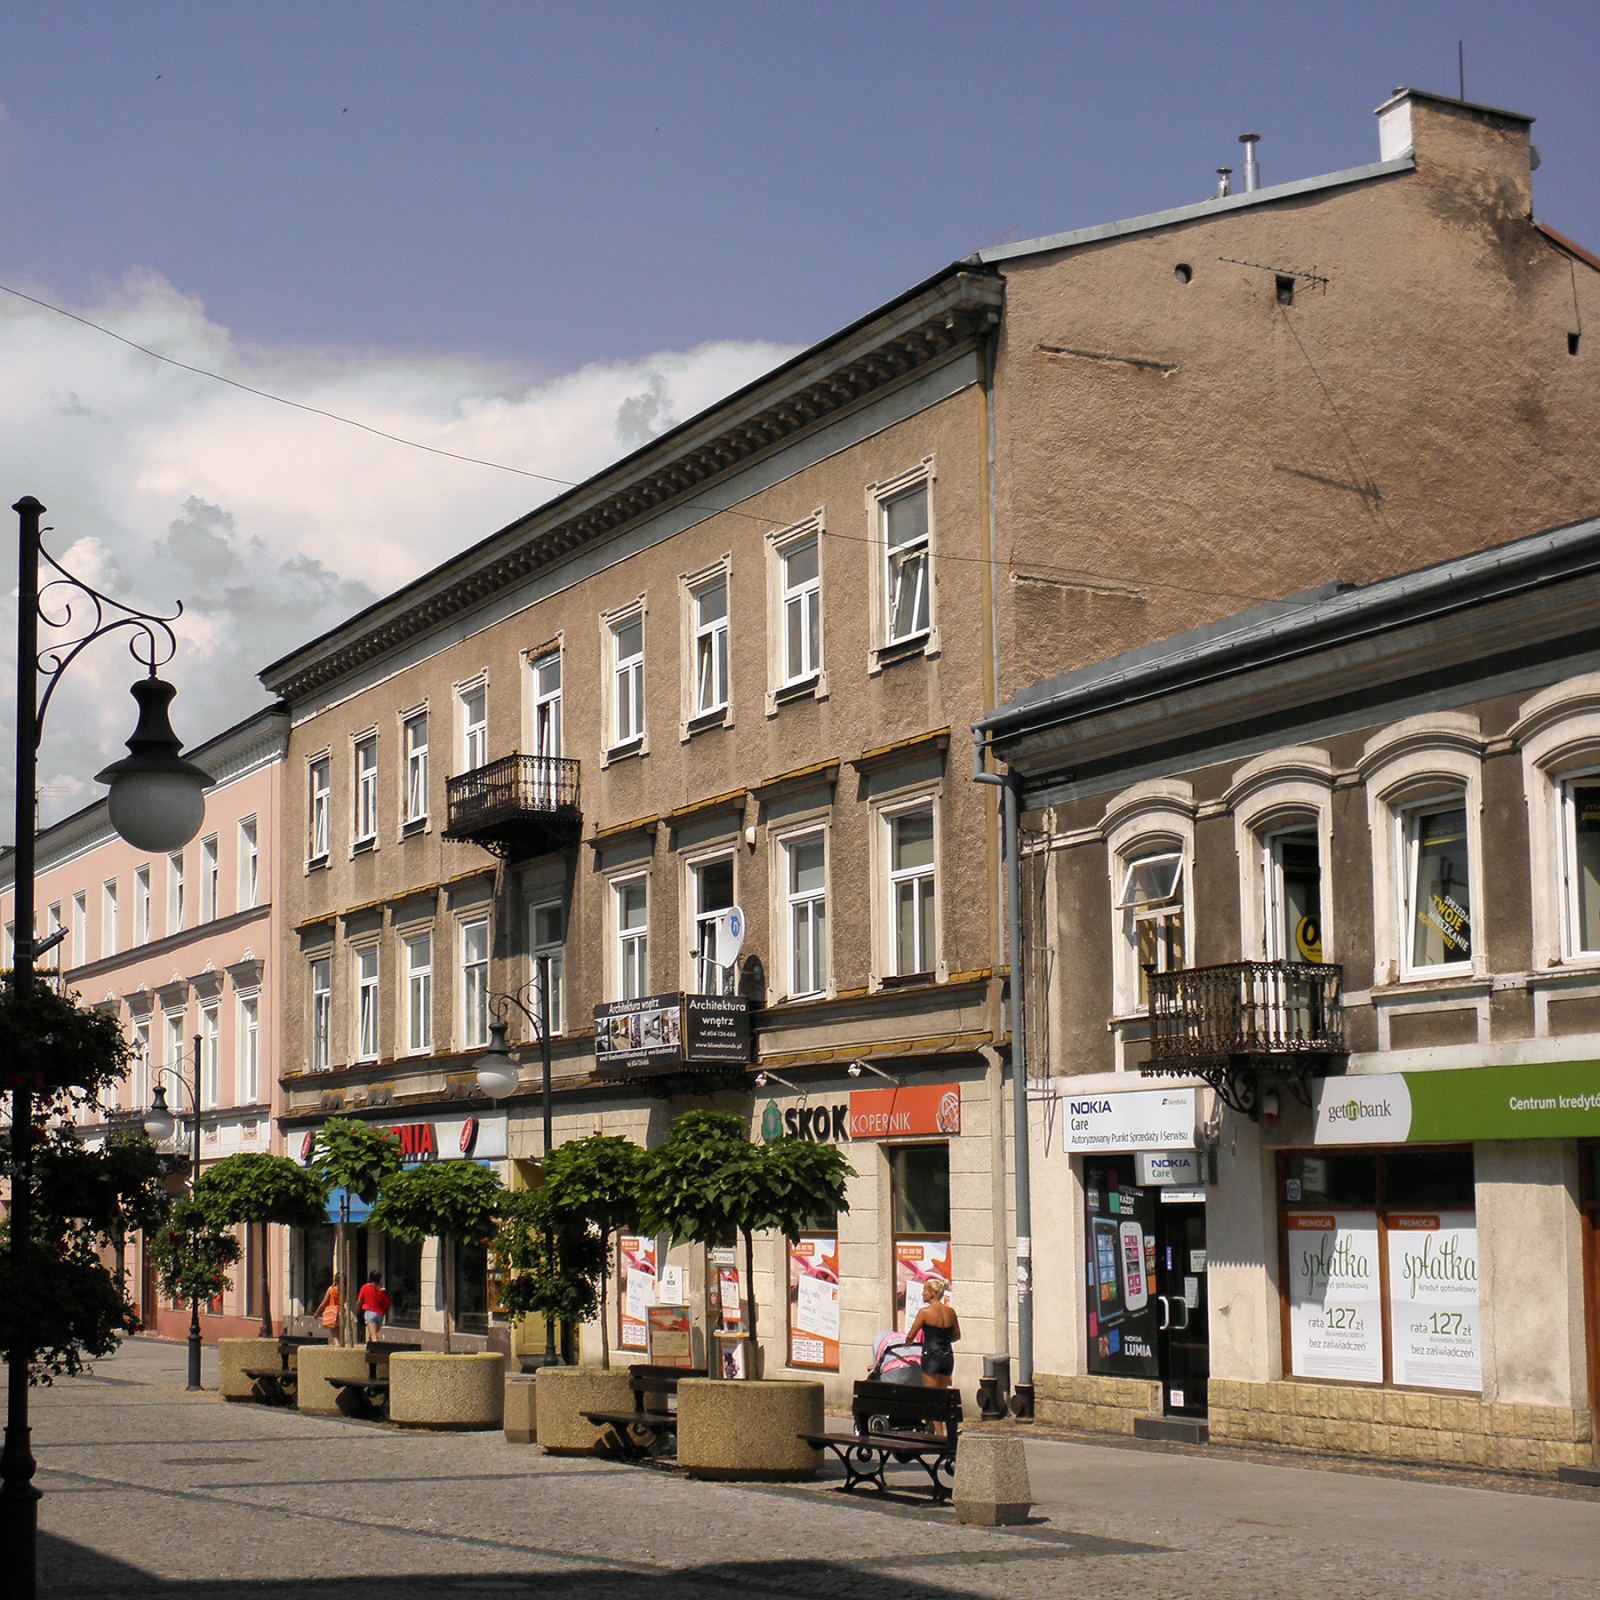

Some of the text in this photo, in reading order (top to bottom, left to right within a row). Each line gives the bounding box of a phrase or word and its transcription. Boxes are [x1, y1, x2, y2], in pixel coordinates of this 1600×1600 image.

[1431, 894, 1463, 931] TWOJE
[689, 999, 746, 1011] Architektura
[701, 1016, 734, 1028] wnętrz
[1070, 1100, 1112, 1115] NOKIA
[1509, 1096, 1556, 1110] Centrum
[785, 1104, 850, 1143] SKOK
[851, 1112, 911, 1133] KOPERNIK
[1071, 1119, 1089, 1131] Care
[1071, 1134, 1111, 1146] Autoryzowany
[1111, 1133, 1129, 1143] Punkt
[1129, 1131, 1159, 1143] Sprzedaży
[1163, 1130, 1189, 1141] Serwisu
[1151, 1159, 1191, 1168] NOKIA
[1152, 1169, 1171, 1178] Care
[1302, 1233, 1371, 1296] spłatka
[1403, 1233, 1479, 1300] spłatka
[1308, 1307, 1364, 1330] rata 127 zł
[1410, 1312, 1472, 1336] rata 127 zł
[1124, 1343, 1152, 1357] LUMIA
[1309, 1338, 1321, 1348] bez
[1411, 1344, 1425, 1355] bez
